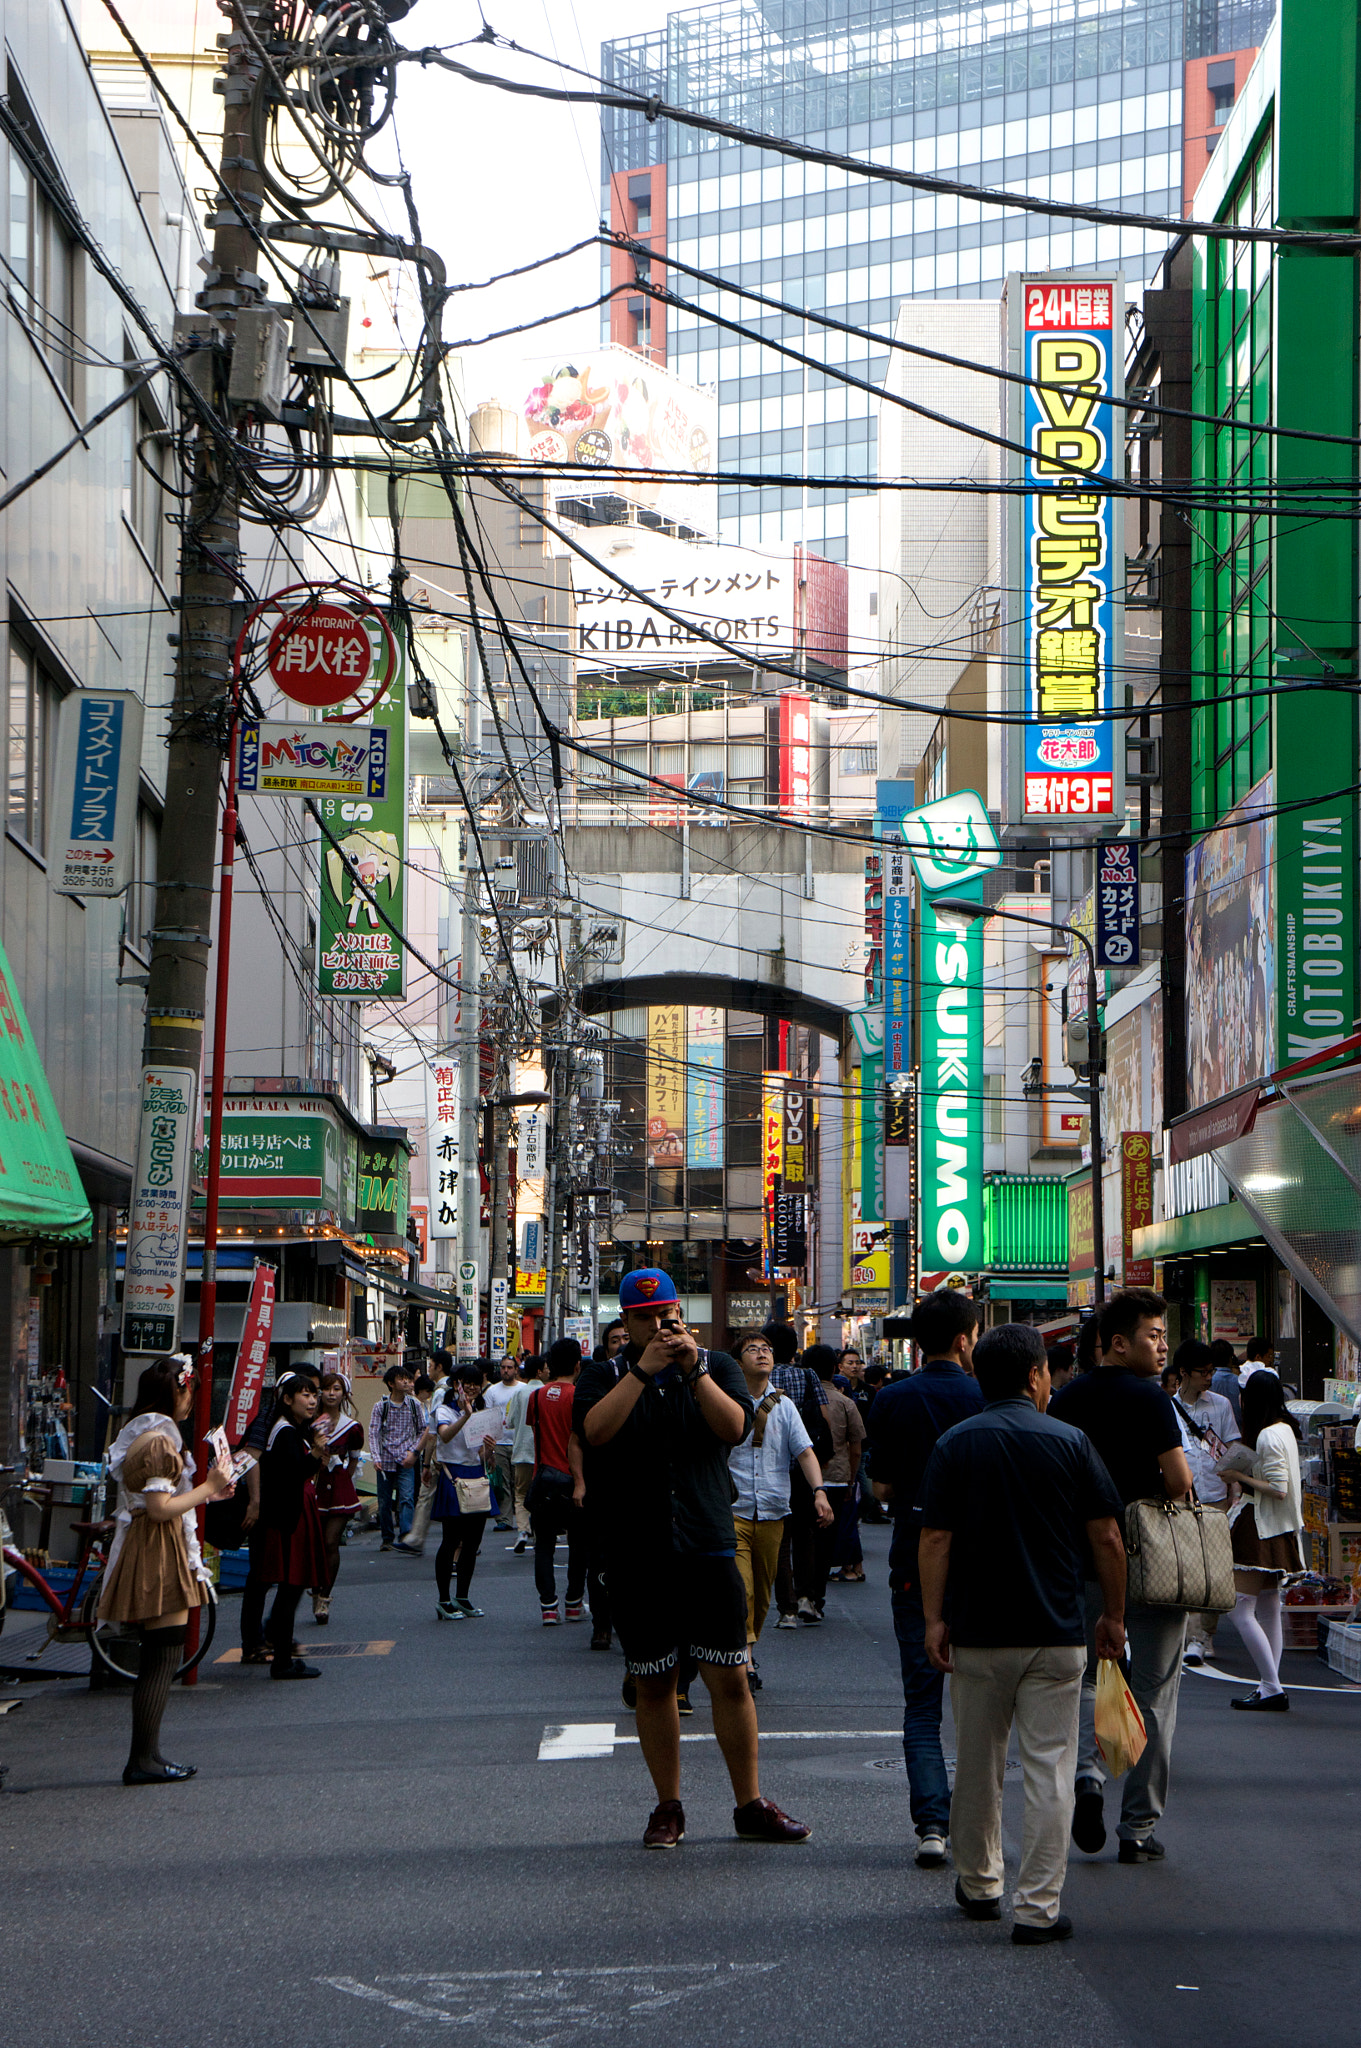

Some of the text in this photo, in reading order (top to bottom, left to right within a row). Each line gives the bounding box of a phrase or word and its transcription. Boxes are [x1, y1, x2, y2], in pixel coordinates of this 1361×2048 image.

[1028, 288, 1110, 327] 24H営業
[577, 570, 780, 605] エンターテインメント
[311, 617, 357, 631] HYDRANT
[579, 615, 779, 650] KIBA RESORTS
[276, 633, 365, 677] 消火栓
[242, 729, 259, 787] パチンコ
[1042, 740, 1095, 760] 花太郎
[77, 701, 115, 840] コスメイトプラス
[370, 737, 385, 794] スロット
[263, 777, 297, 789] 錦糸町駅
[1026, 777, 1112, 813] 受付3F
[65, 849, 93, 861] この先
[64, 864, 115, 876] 秋月電子5F
[1101, 867, 1136, 883] No.1
[63, 876, 114, 888] 3526-5013
[889, 886, 906, 896] 6F
[1102, 886, 1118, 931] カフェ
[1119, 886, 1136, 934] メイド
[332, 933, 392, 951] 入り口は
[1287, 817, 1345, 1058] KOTOBUKIYA
[1108, 940, 1129, 957] 2F
[322, 953, 400, 971] ビル正面に
[1287, 912, 1297, 1017] CRAFTSMANSHIP
[332, 972, 388, 990] あります
[891, 1021, 904, 1029] 2F
[150, 1087, 183, 1100] アニメ
[435, 1066, 455, 1124] 菊正宗
[143, 1100, 188, 1114] リサイクル
[784, 1090, 805, 1183] DVD買取
[147, 1116, 177, 1186] なごみ
[141, 1188, 177, 1200] 営業時間
[155, 1259, 178, 1267] www.
[129, 1268, 178, 1279] nagomi.ne.jp
[127, 1285, 154, 1295] この先
[731, 1300, 761, 1308] PASELA
[131, 1322, 166, 1334] 外神田
[133, 1336, 164, 1347] 1-11
